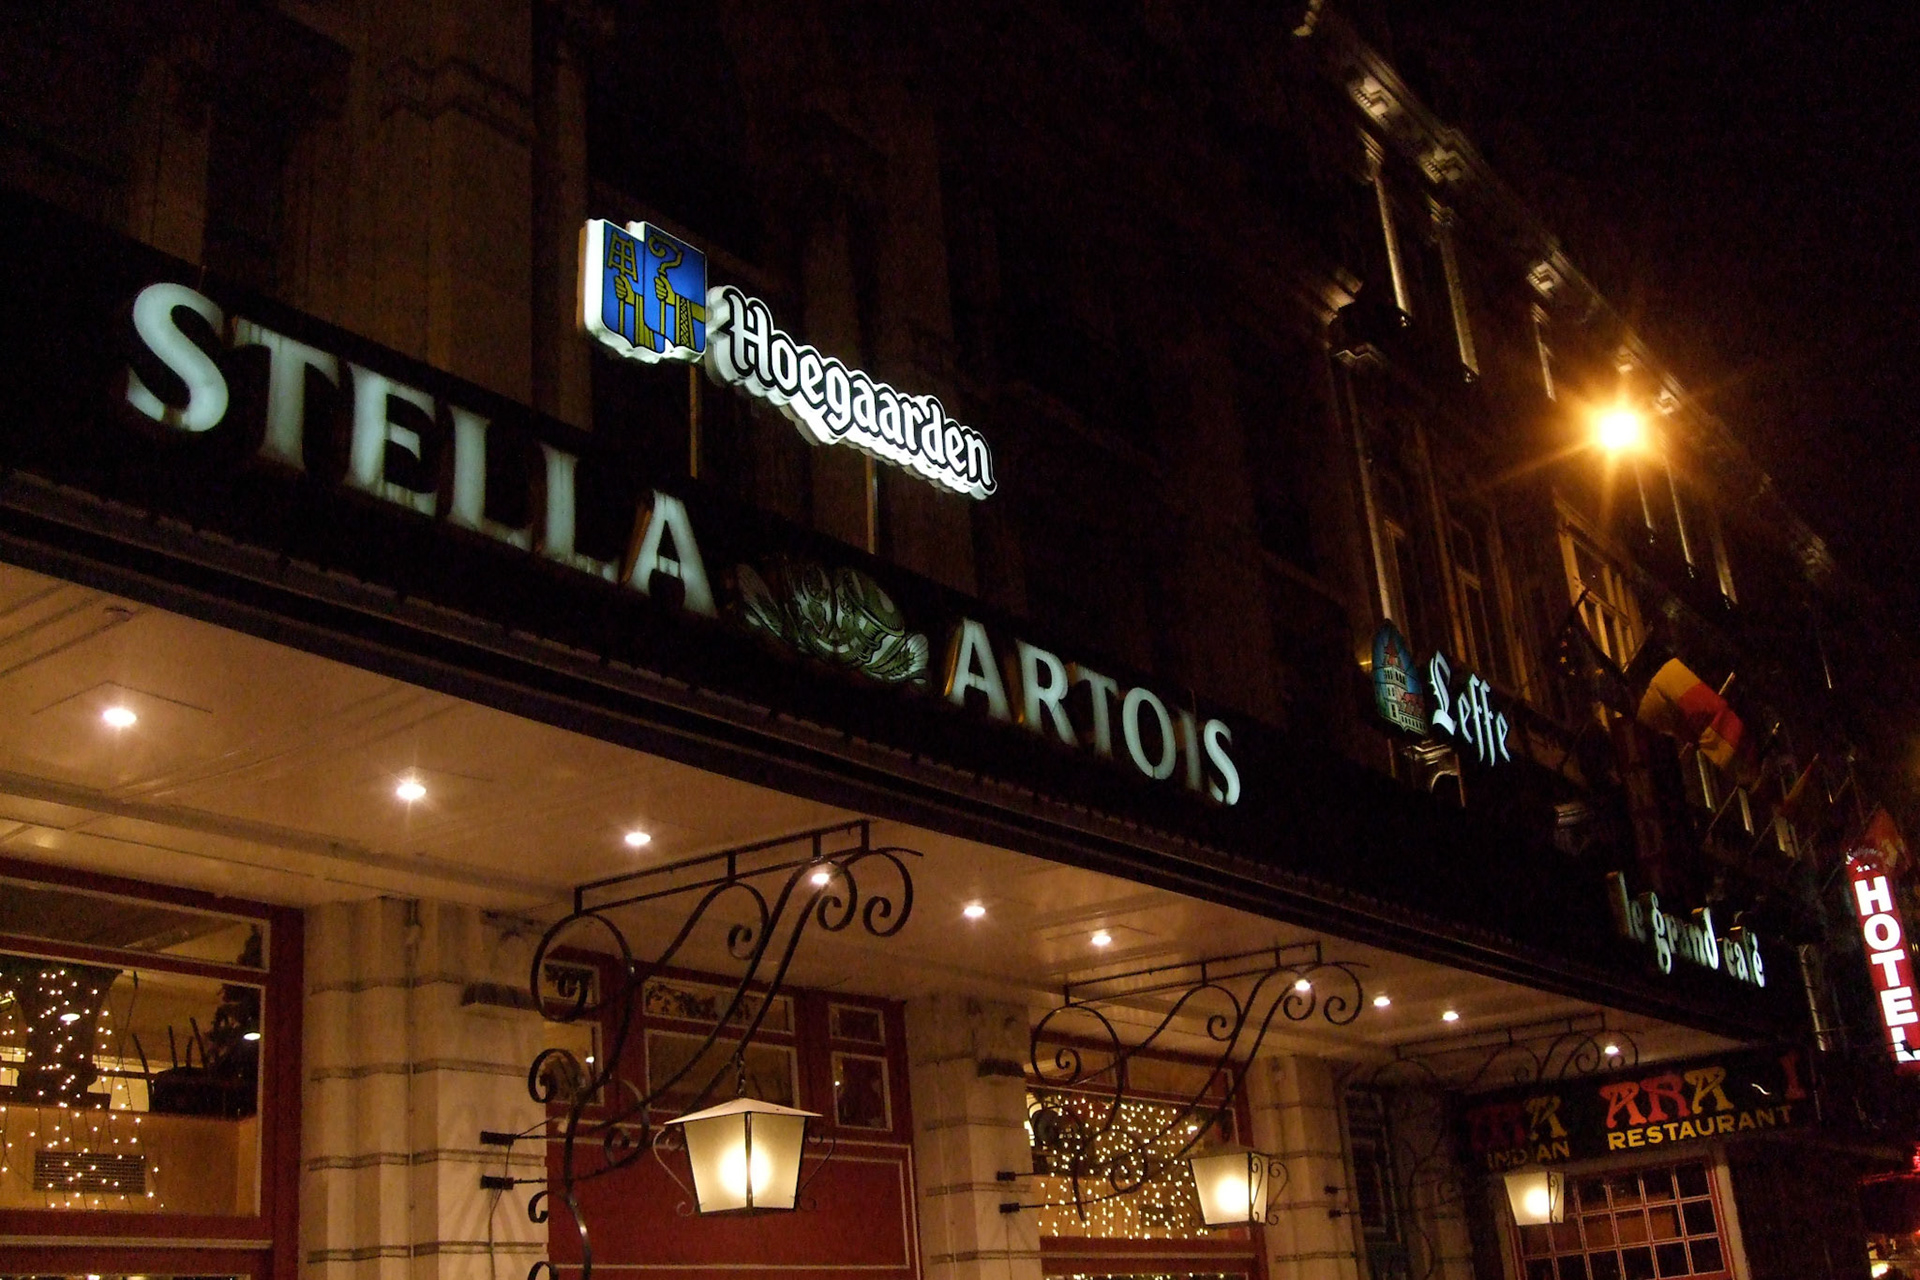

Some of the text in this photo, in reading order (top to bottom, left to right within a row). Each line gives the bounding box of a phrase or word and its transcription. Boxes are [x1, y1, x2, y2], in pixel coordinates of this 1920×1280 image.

[723, 288, 998, 494] Hoegaarden
[126, 282, 1242, 806] STELLA ARTOIS
[1429, 650, 1511, 767] Leffe
[1855, 876, 1920, 1063] HOTEL
[1486, 1104, 1793, 1171] INDAN RESTAURANT
